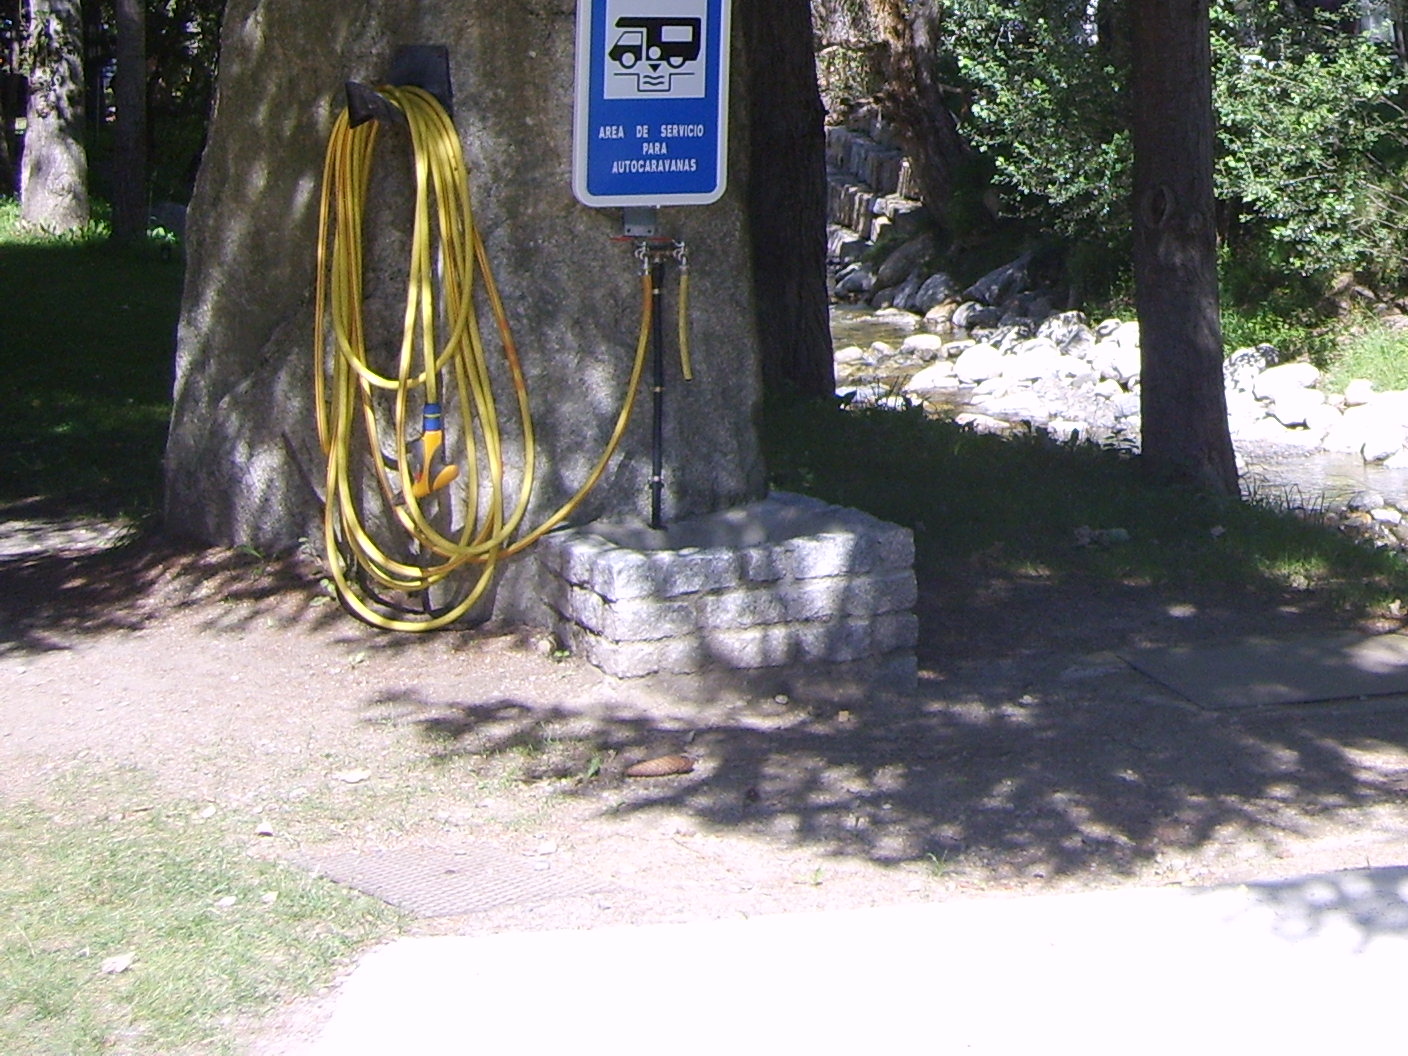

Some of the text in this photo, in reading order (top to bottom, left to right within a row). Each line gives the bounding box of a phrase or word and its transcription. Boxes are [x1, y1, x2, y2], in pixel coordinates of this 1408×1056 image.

[599, 124, 704, 139] AREA DE SERVICIO
[642, 142, 667, 155] PARA
[612, 159, 697, 174] AUTOCARAVANAS
